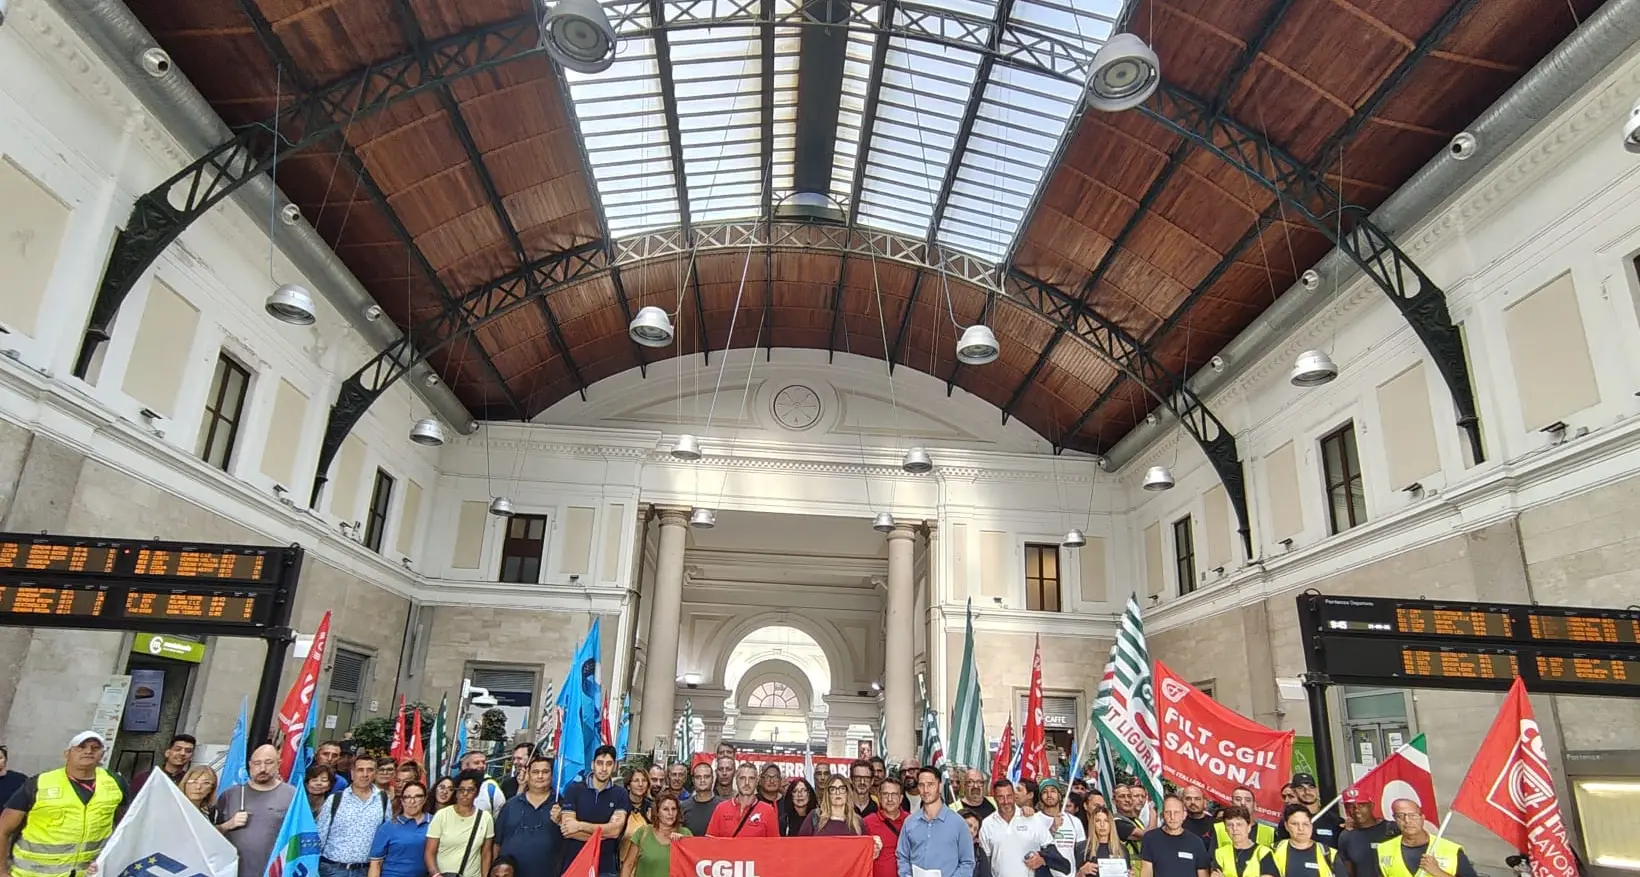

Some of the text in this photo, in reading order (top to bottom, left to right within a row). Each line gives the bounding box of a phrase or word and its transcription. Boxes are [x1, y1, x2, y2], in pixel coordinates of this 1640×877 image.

[1116, 720, 1160, 775] LIGURIA
[1164, 707, 1278, 770] FILT CGIL
[1164, 732, 1261, 790] SAVONA
[695, 859, 760, 877] CGIL
